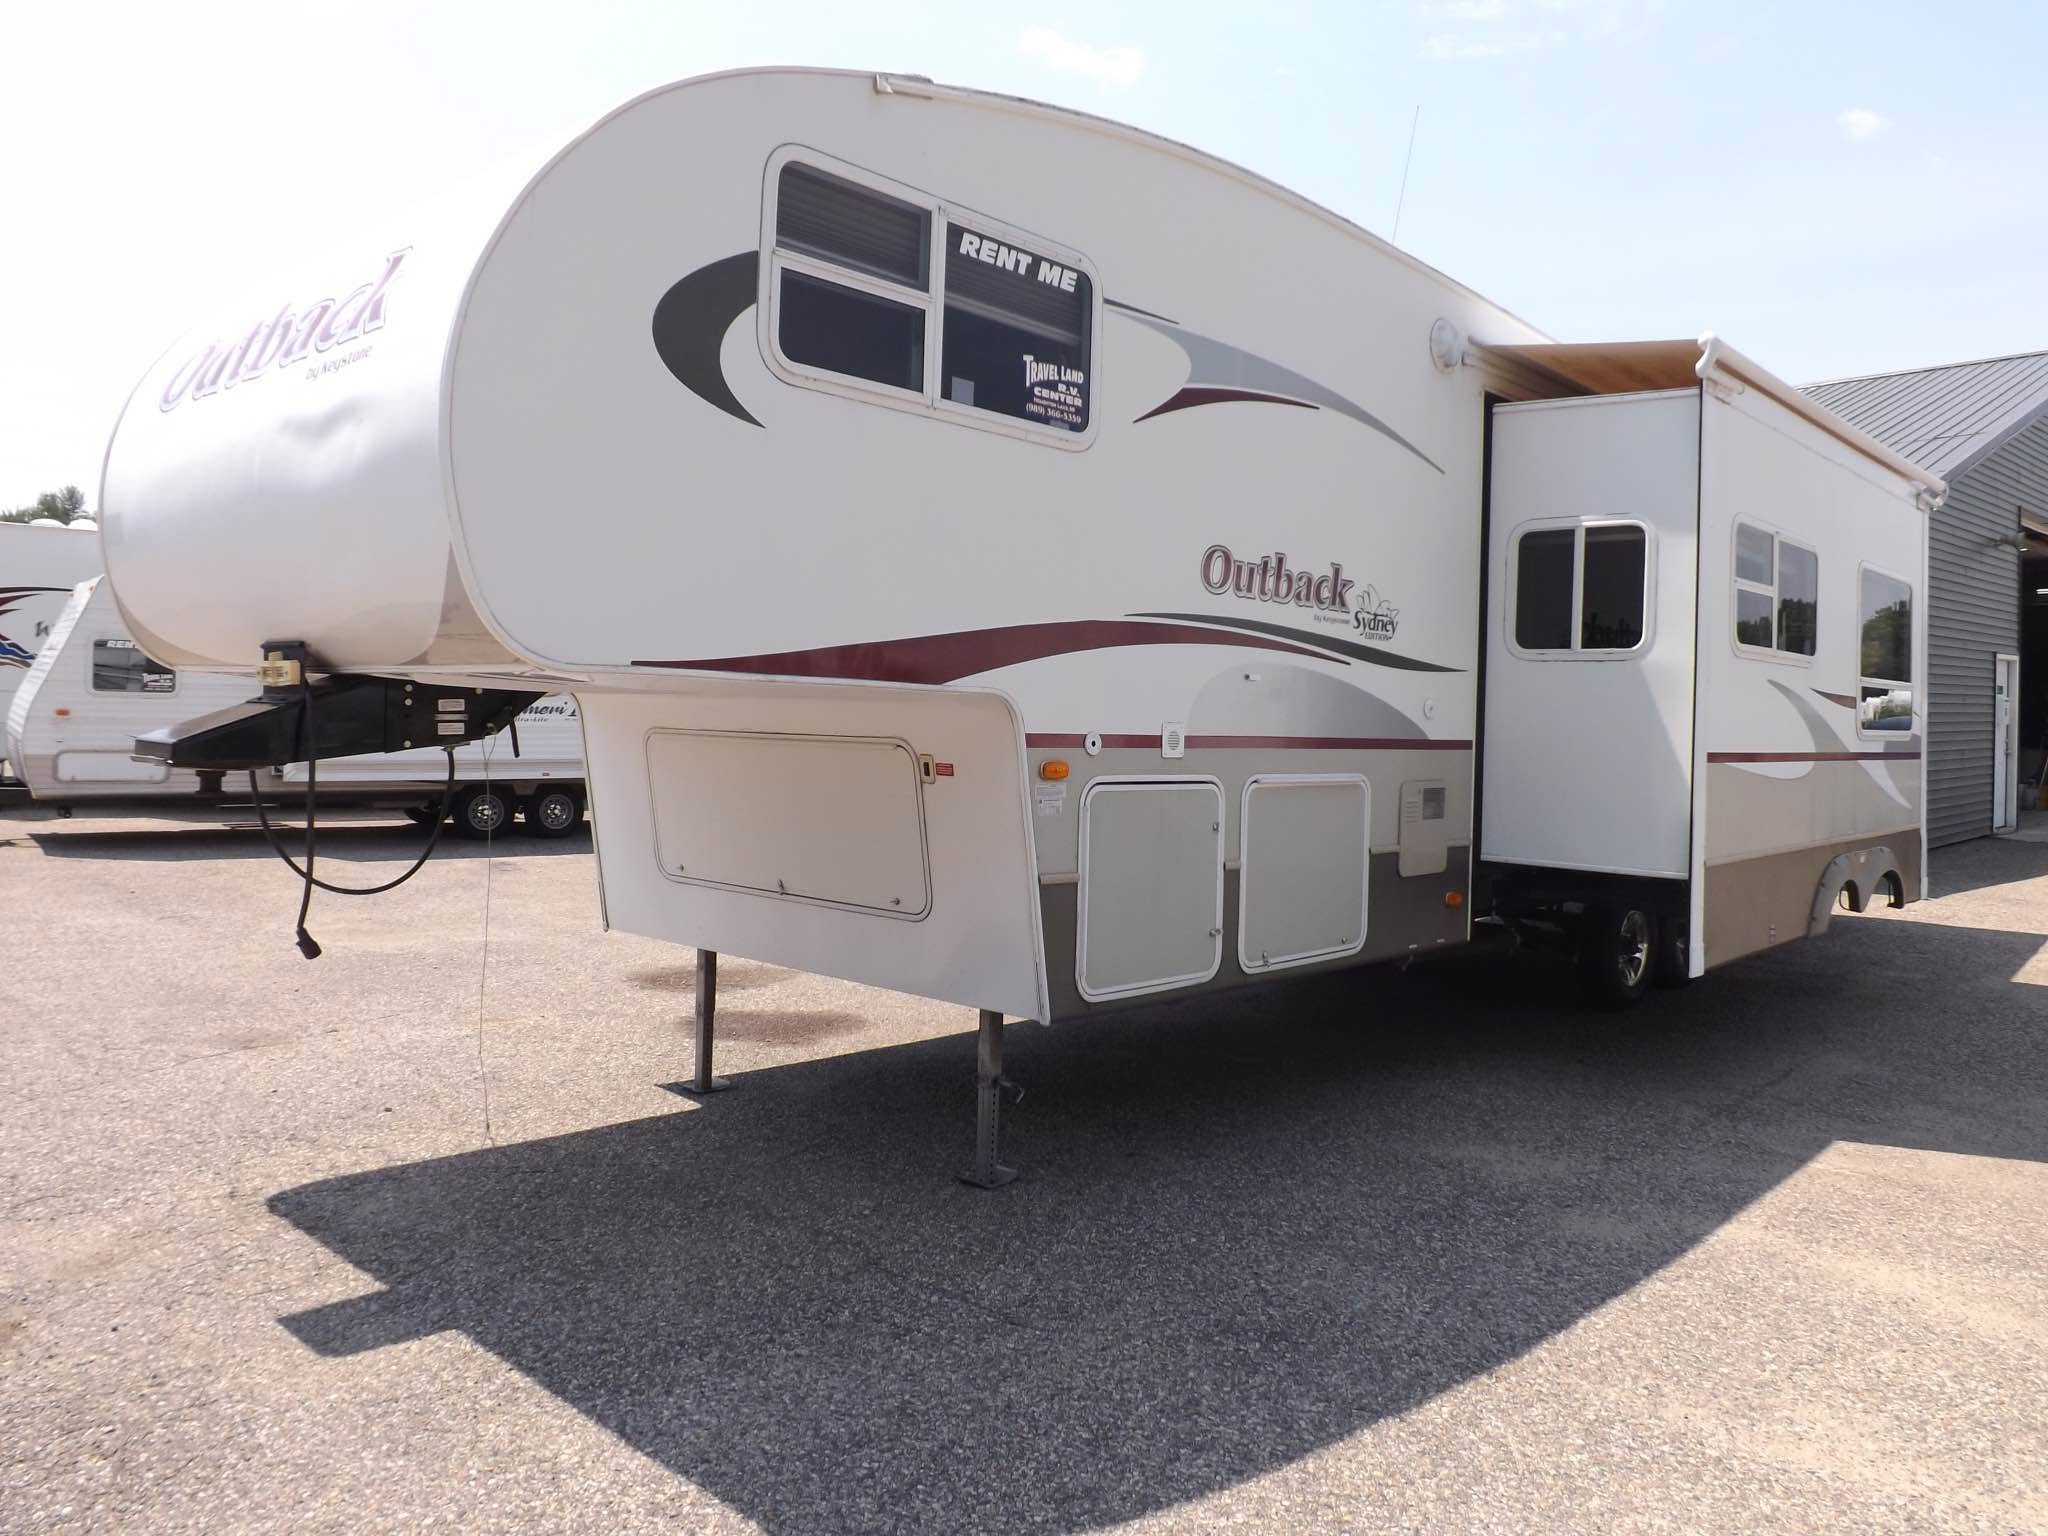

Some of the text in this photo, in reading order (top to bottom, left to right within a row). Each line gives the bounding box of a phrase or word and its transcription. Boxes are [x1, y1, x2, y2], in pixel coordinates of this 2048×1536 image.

[960, 232, 1077, 293] RENT ME
[159, 245, 413, 413] Outback
[1023, 354, 1084, 388] TRAVEL LAND
[1034, 386, 1082, 407] CENTER
[1058, 383, 1080, 397] R.V.
[1201, 545, 1354, 613] Outback
[1352, 608, 1399, 639] Sydney
